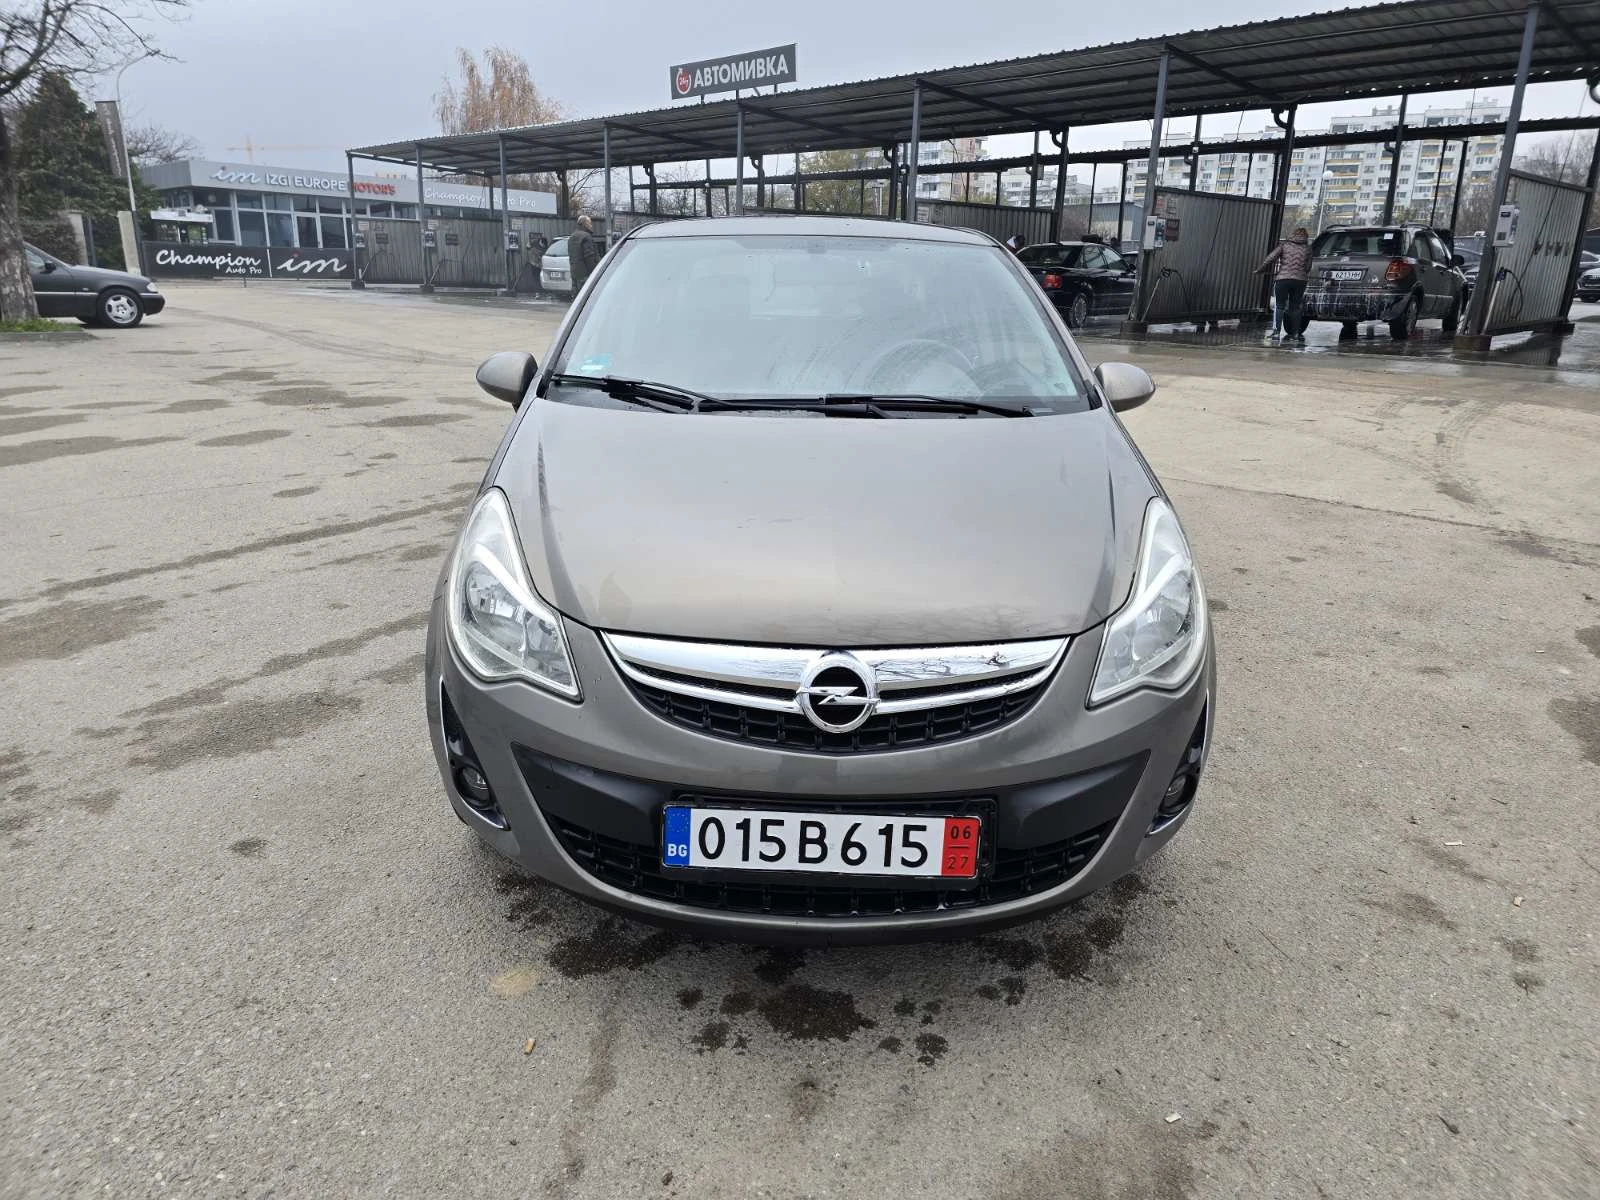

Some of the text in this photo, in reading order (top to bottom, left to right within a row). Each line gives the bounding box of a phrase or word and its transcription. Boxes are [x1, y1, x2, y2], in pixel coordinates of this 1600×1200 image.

[693, 54, 788, 88] АВТОМИВКА
[265, 173, 292, 187] IZGI
[295, 176, 347, 192] EUROPE
[156, 249, 261, 269] Champion
[225, 266, 262, 274] Auto Pro
[667, 816, 929, 868] BG 015B615
[950, 825, 972, 841] 06
[947, 854, 969, 870] 27
